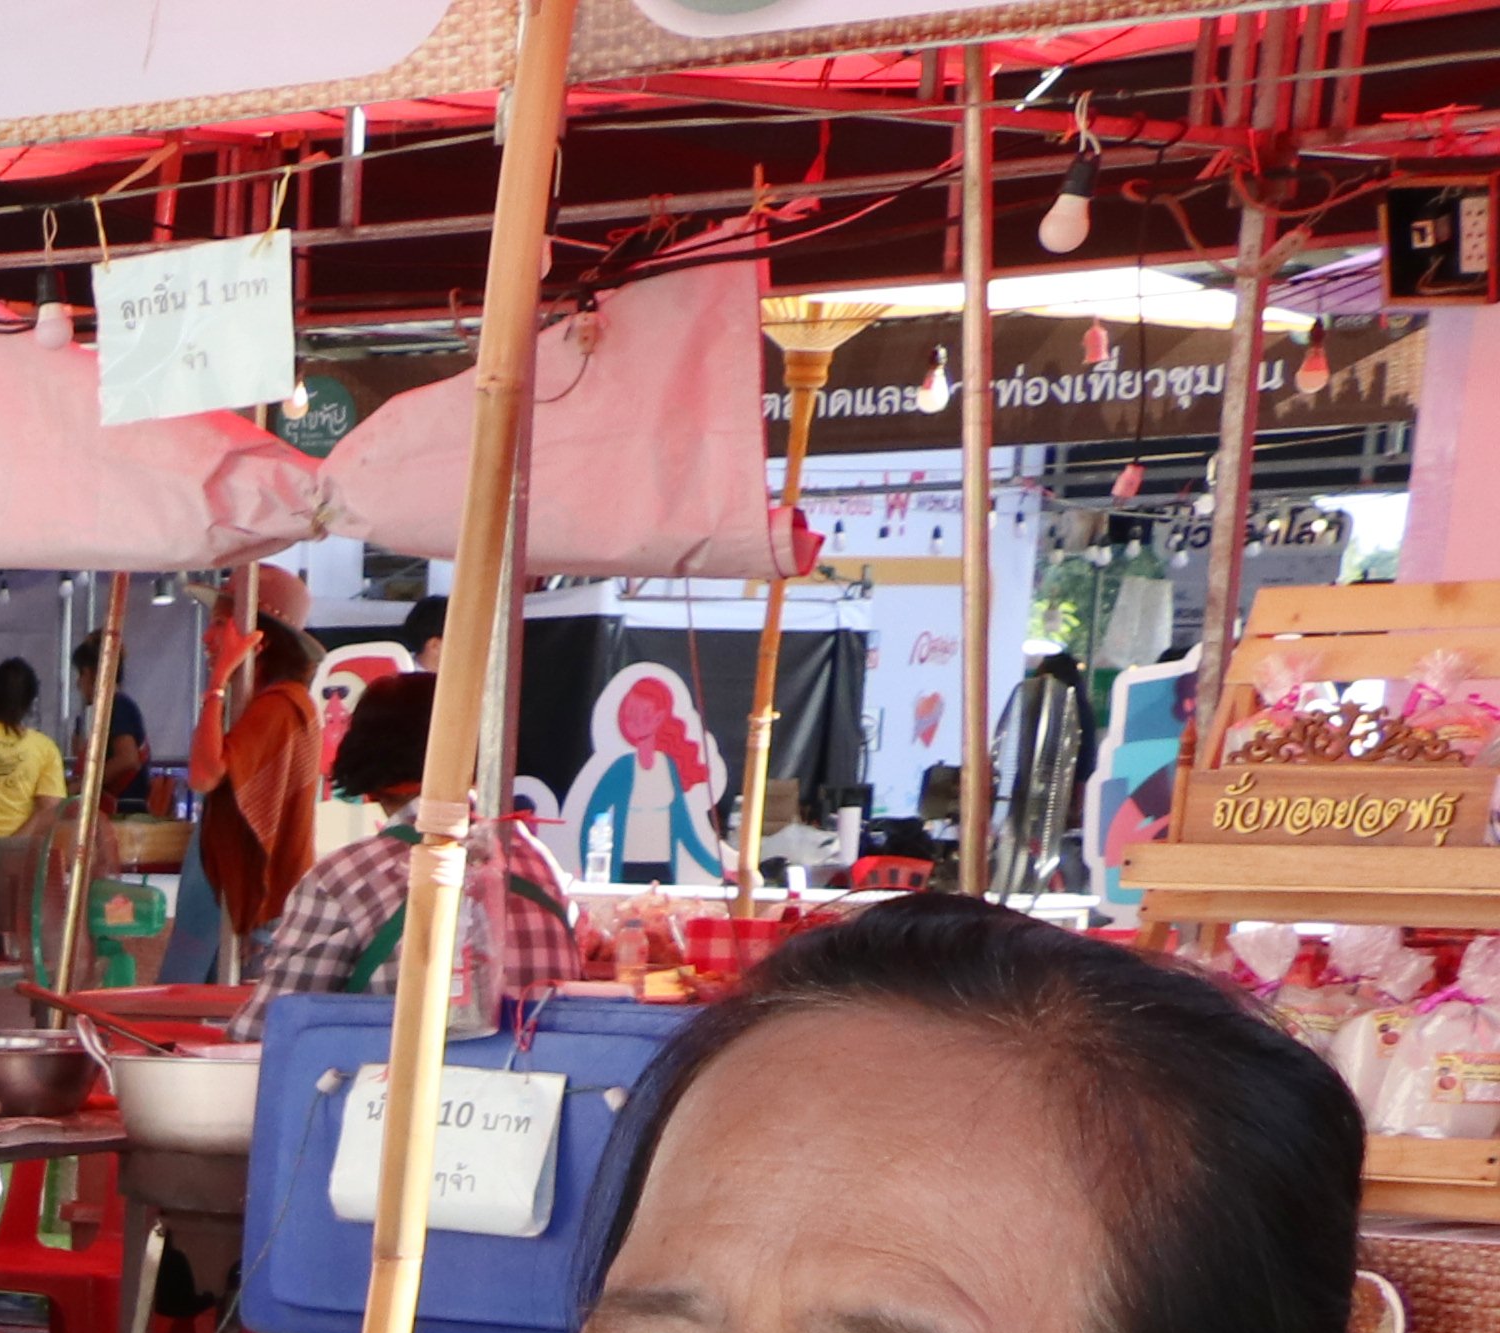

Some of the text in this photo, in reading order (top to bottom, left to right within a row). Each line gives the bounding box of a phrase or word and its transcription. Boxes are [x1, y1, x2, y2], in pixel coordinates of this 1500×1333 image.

[120, 274, 269, 331] ลูกชิ้น 1 บาท
[437, 1100, 475, 1128] 10
[482, 1112, 532, 1135] บาท
